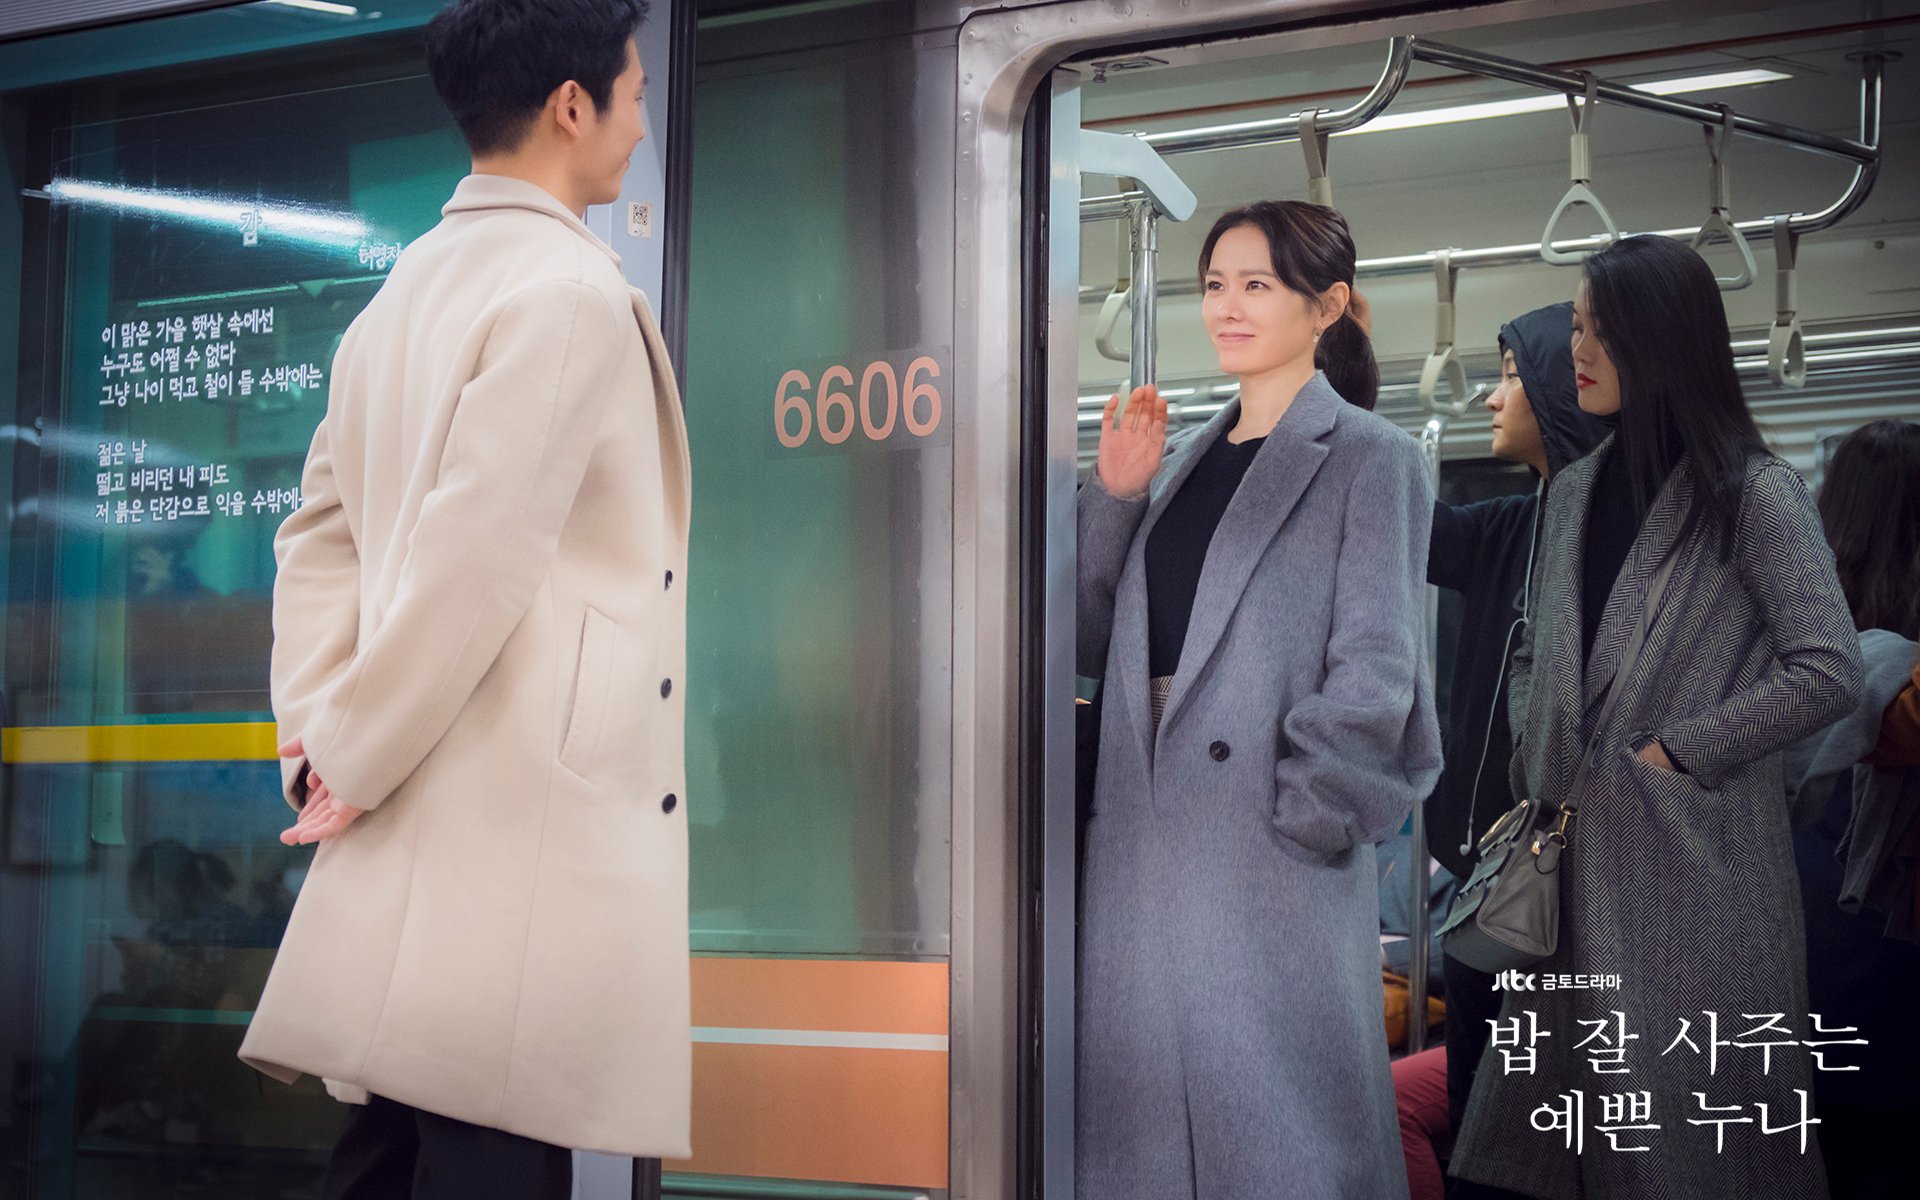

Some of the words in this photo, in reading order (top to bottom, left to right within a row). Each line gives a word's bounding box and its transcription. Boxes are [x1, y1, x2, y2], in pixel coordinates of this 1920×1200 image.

[240, 208, 262, 247] 감
[101, 323, 116, 349] 이
[121, 320, 151, 348] 맑은
[156, 317, 187, 343] 가을
[191, 312, 224, 340] 햇살
[227, 306, 274, 337] 속에선
[100, 352, 146, 379] 누구도
[150, 345, 180, 373] 어쩔
[184, 345, 201, 370] 수
[205, 340, 236, 369] 없다
[99, 381, 130, 407] 그냥
[135, 378, 164, 403] 나이
[169, 375, 199, 401] 먹고
[204, 370, 233, 399] 철이
[238, 369, 254, 395] 들
[259, 363, 323, 393] 수밖에는
[774, 356, 942, 448] 6606
[98, 442, 126, 467] 젊은
[131, 439, 147, 464] 날
[96, 471, 126, 496] 떫고
[131, 466, 173, 492] 비리던
[179, 465, 194, 489] 내
[199, 463, 230, 487] 피도
[95, 501, 110, 523] 저
[114, 499, 144, 524] 붉은
[150, 495, 211, 522] 단감으로
[215, 491, 246, 516] 익을
[251, 486, 304, 514] 수밖에
